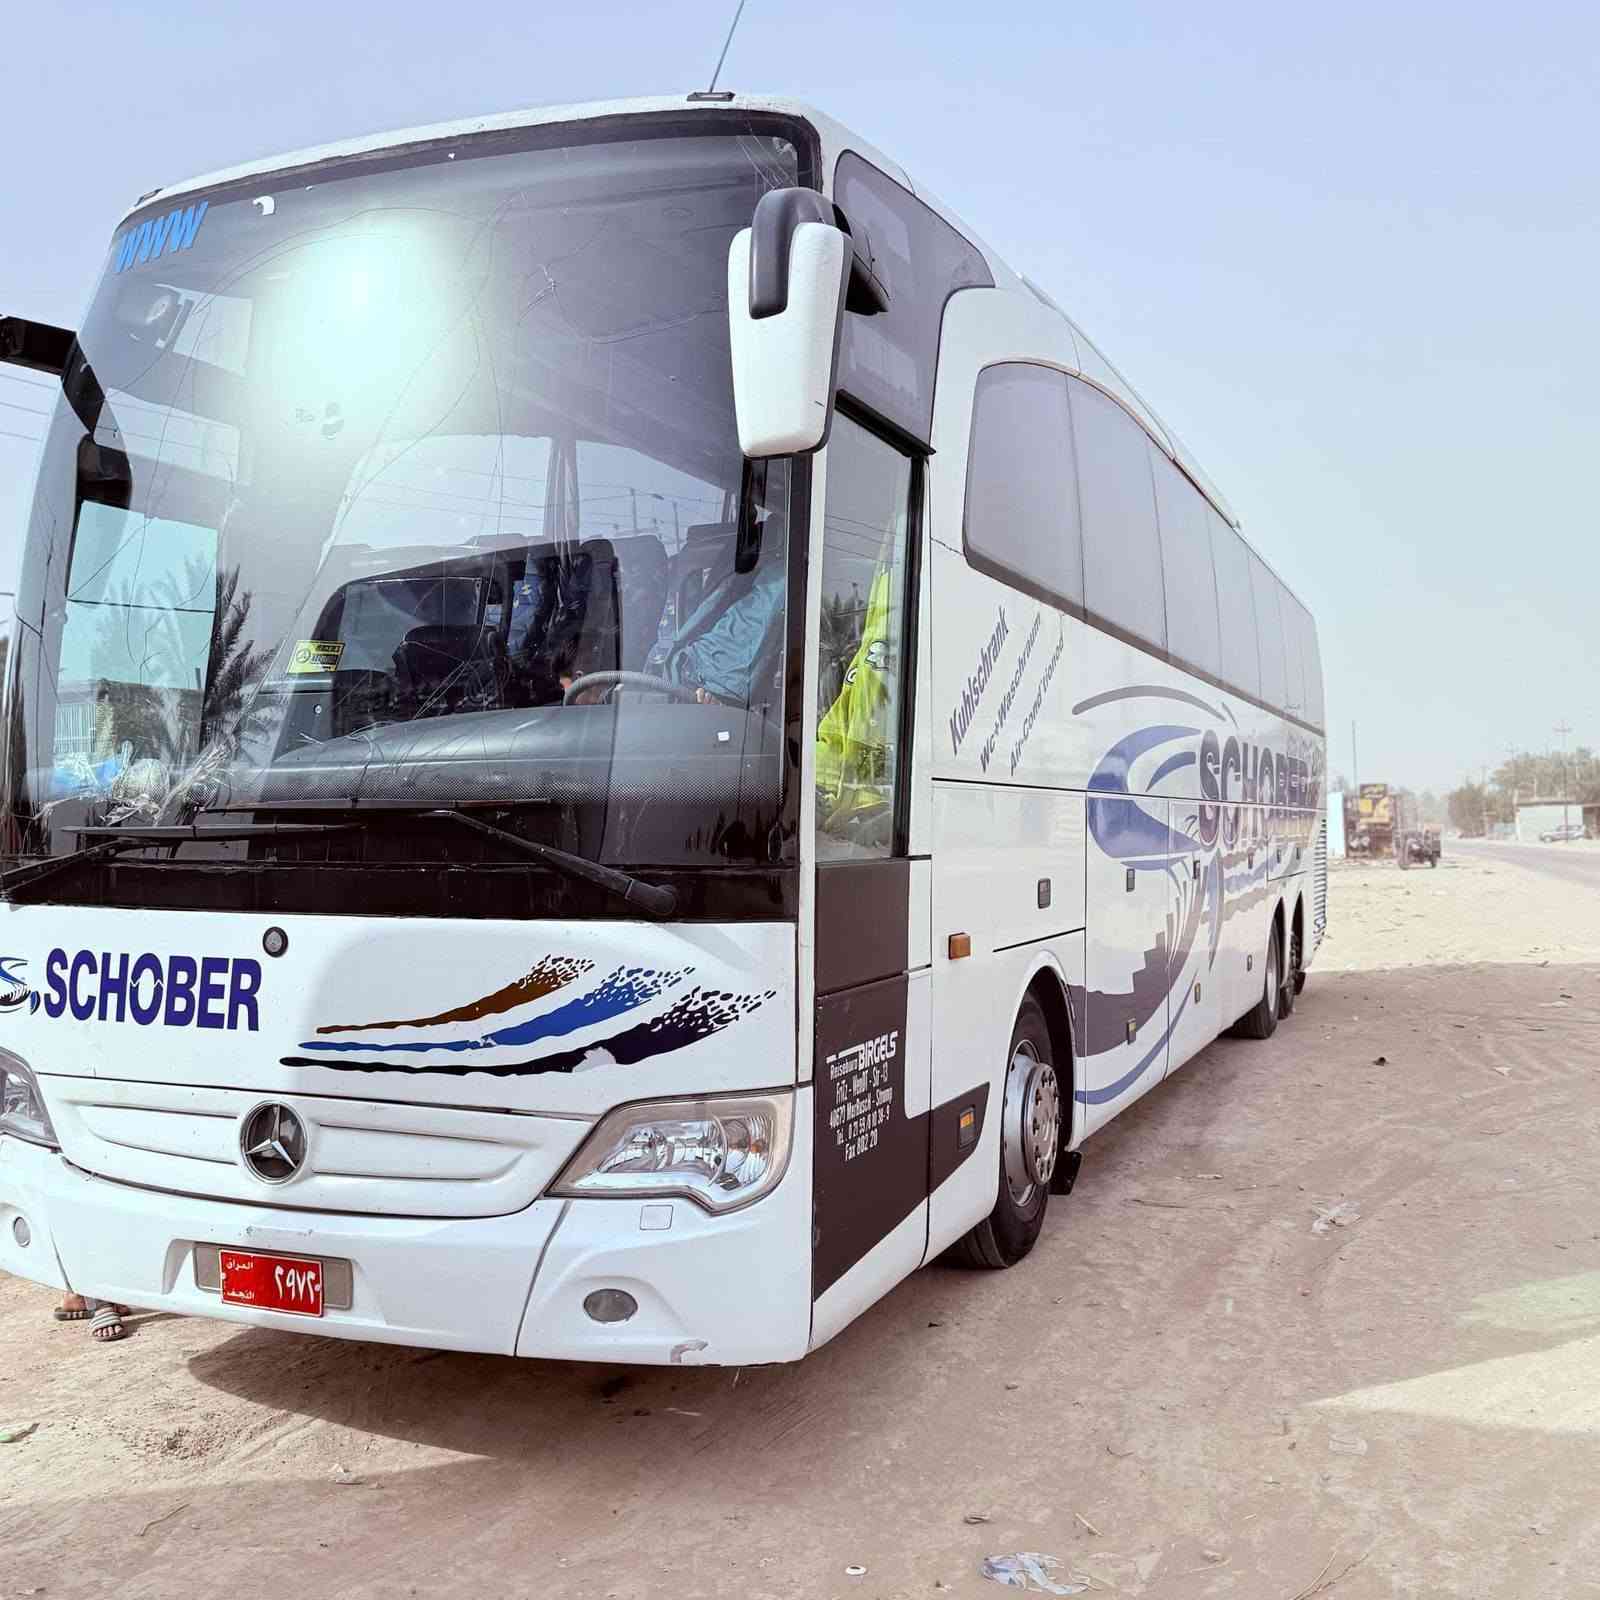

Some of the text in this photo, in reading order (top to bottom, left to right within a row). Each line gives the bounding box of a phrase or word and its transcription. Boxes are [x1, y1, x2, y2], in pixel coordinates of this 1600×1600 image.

[1199, 729, 1310, 852] SCHOBER
[44, 948, 262, 1031] SCHOBER
[225, 1257, 254, 1271] العراق
